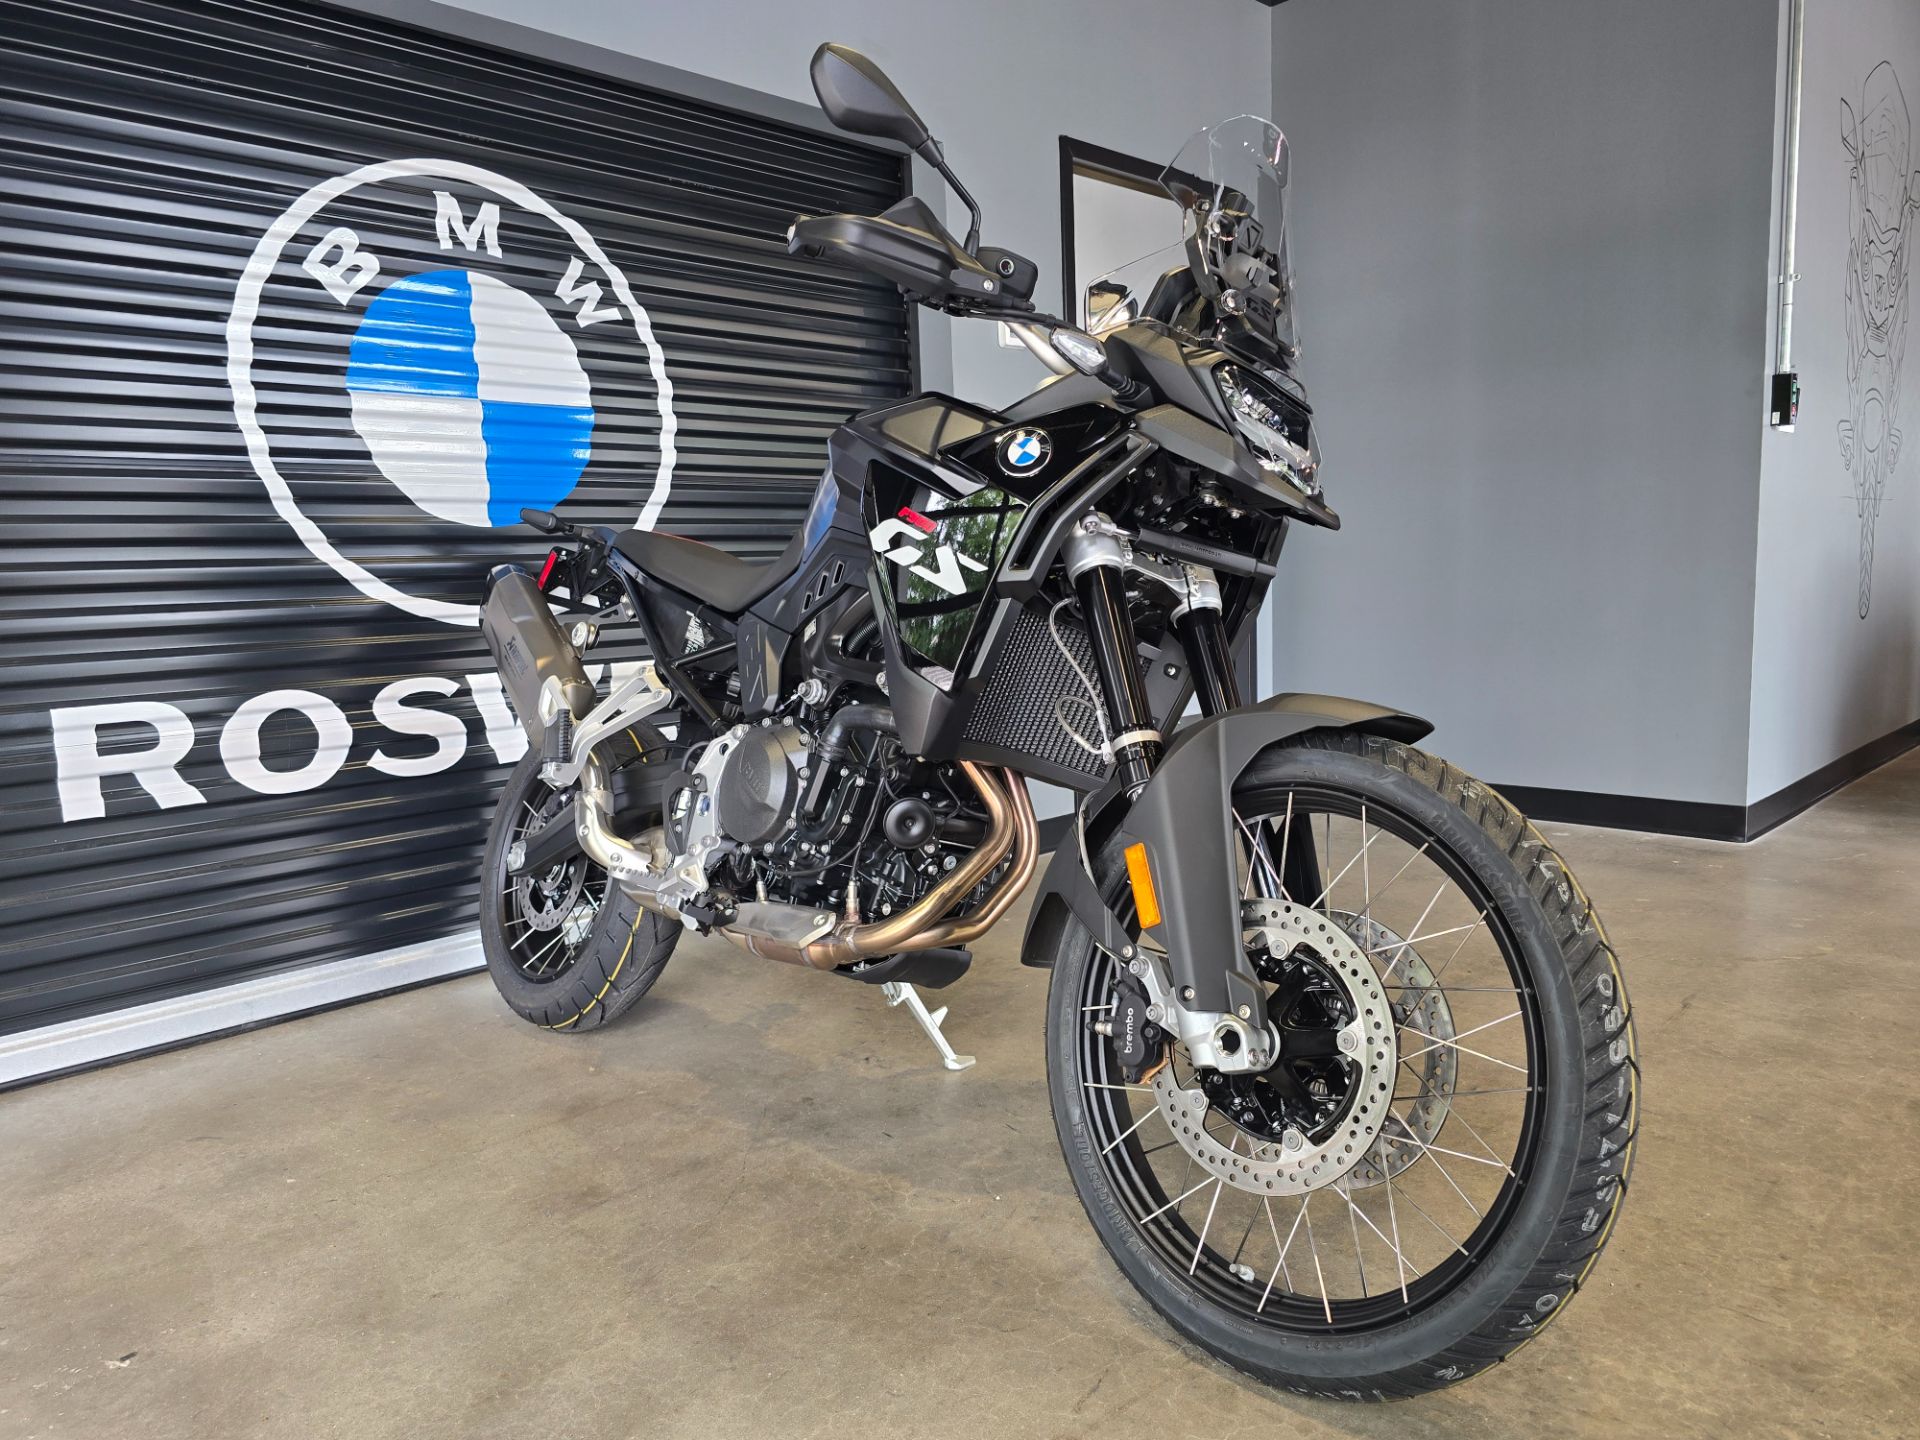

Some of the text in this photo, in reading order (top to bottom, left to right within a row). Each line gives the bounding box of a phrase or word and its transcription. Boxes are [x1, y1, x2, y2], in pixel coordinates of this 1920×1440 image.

[302, 189, 623, 329] BMW
[869, 517, 989, 596] GS
[1124, 1007, 1134, 1054] brembo
